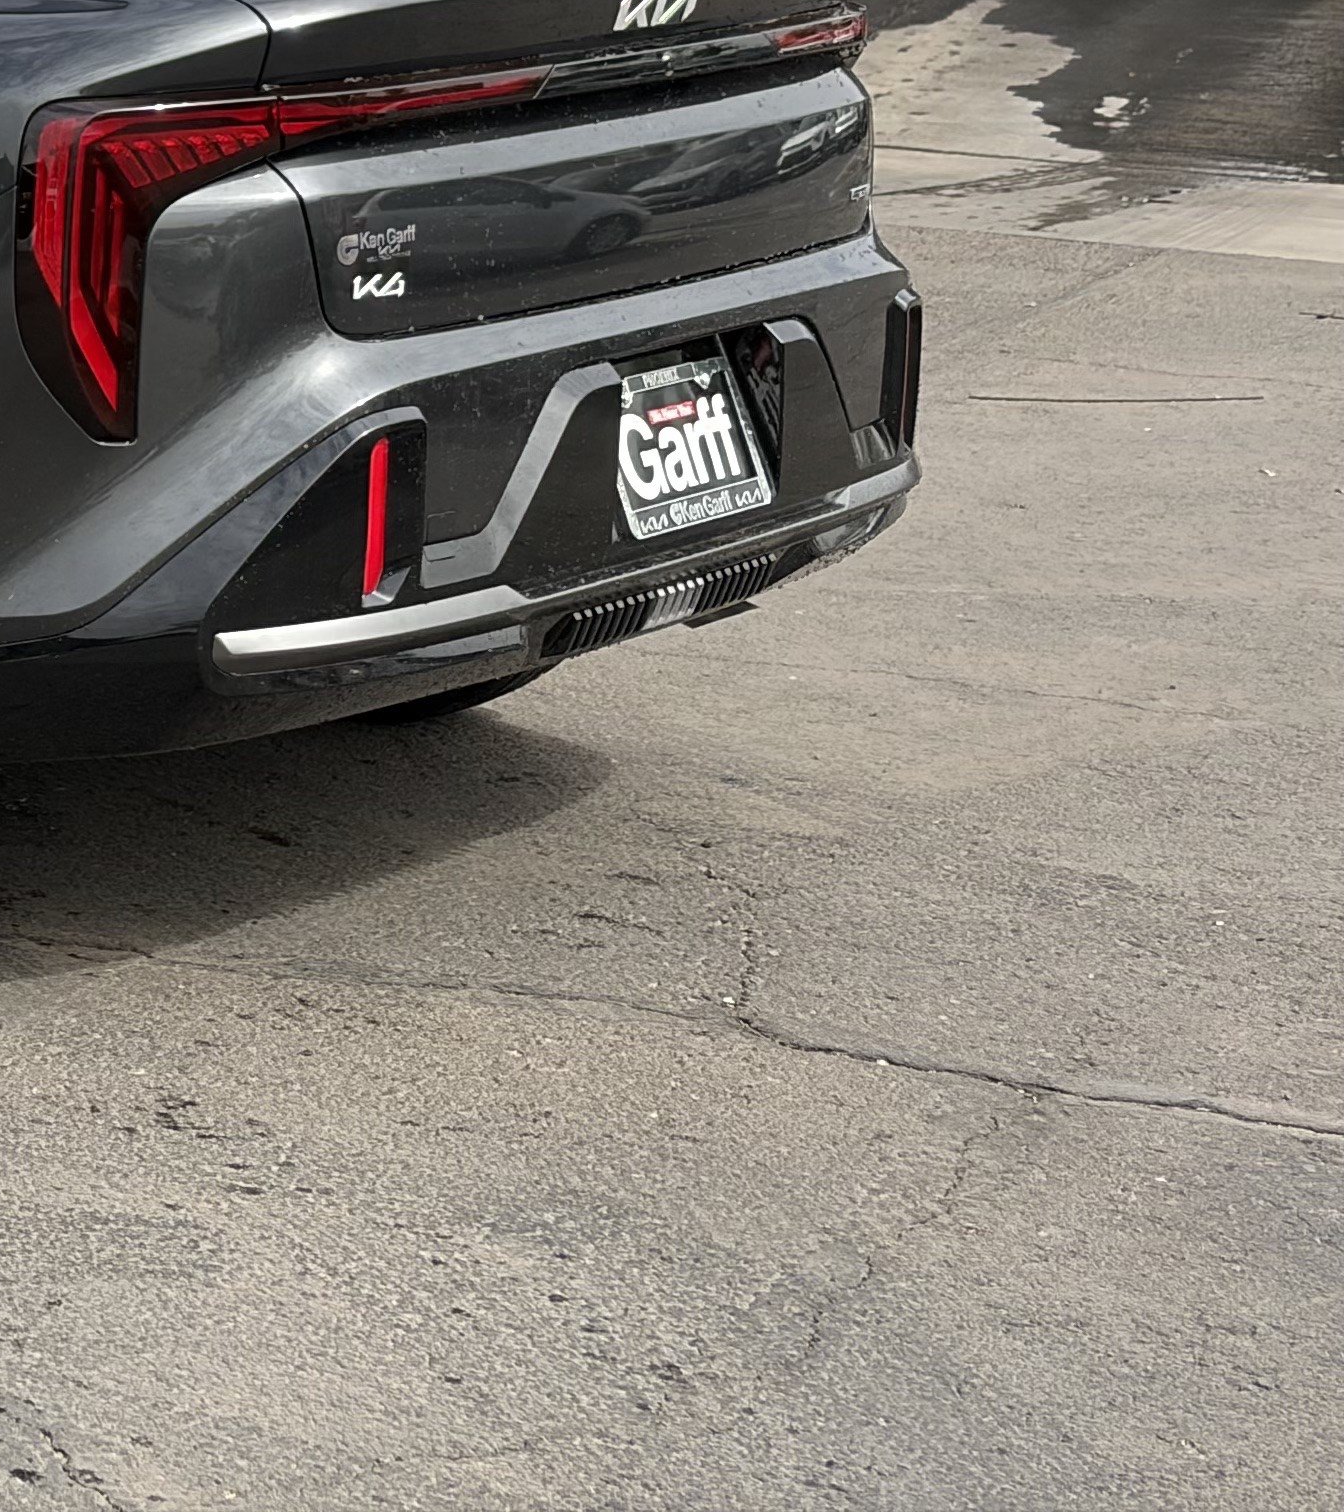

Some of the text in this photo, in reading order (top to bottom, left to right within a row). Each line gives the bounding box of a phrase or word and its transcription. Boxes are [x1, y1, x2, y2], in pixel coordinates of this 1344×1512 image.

[359, 230, 385, 250] Ken
[352, 271, 406, 300] K4
[618, 392, 742, 501] Garff
[682, 500, 705, 524] Ken
